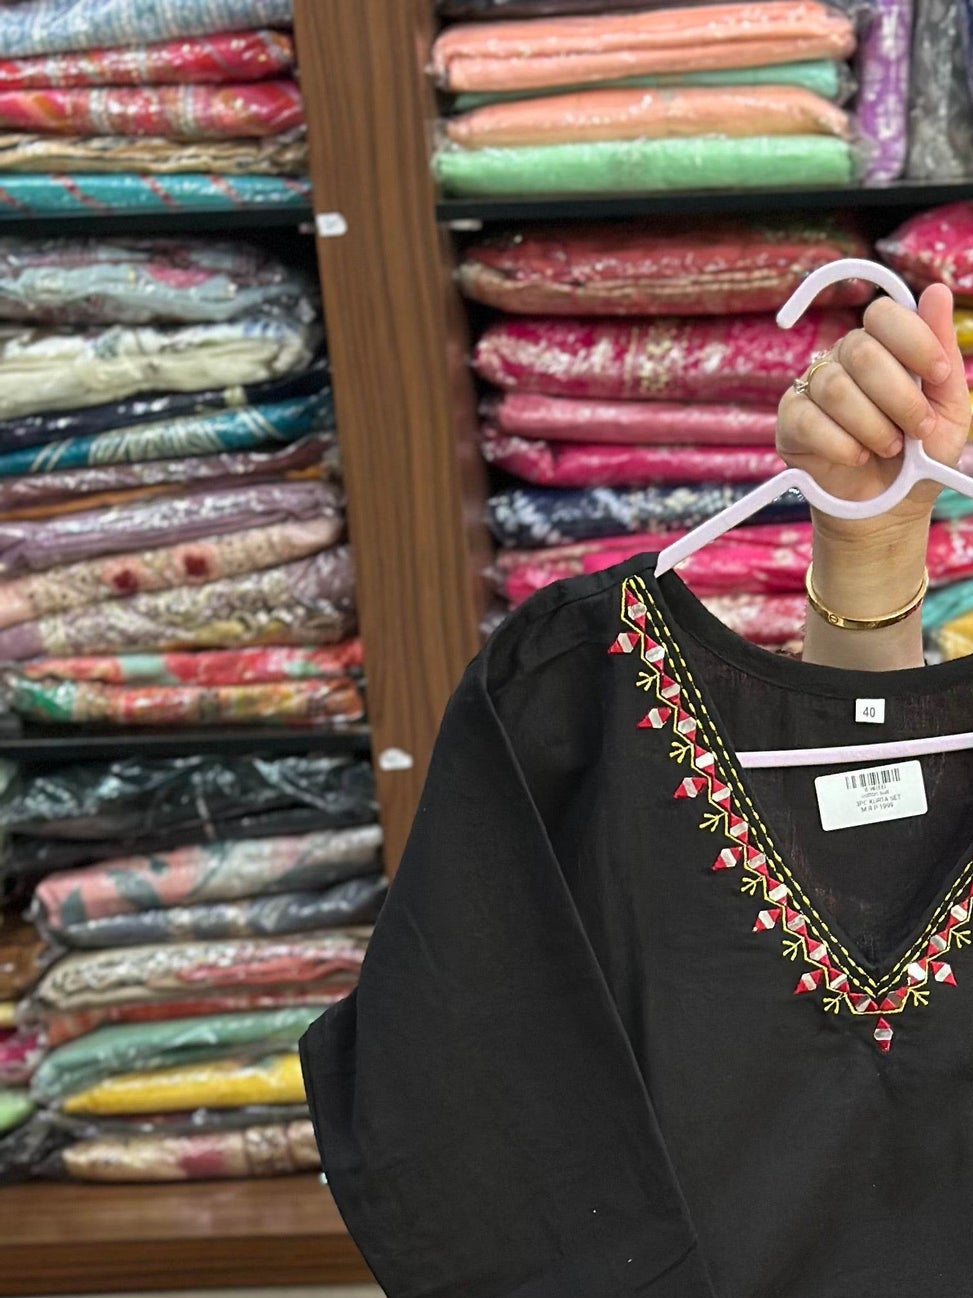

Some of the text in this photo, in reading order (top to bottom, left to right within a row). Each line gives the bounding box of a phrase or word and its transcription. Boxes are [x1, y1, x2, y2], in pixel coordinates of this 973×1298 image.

[862, 706, 876, 718] 40
[869, 796, 889, 804] KURTA
[890, 793, 901, 801] SET
